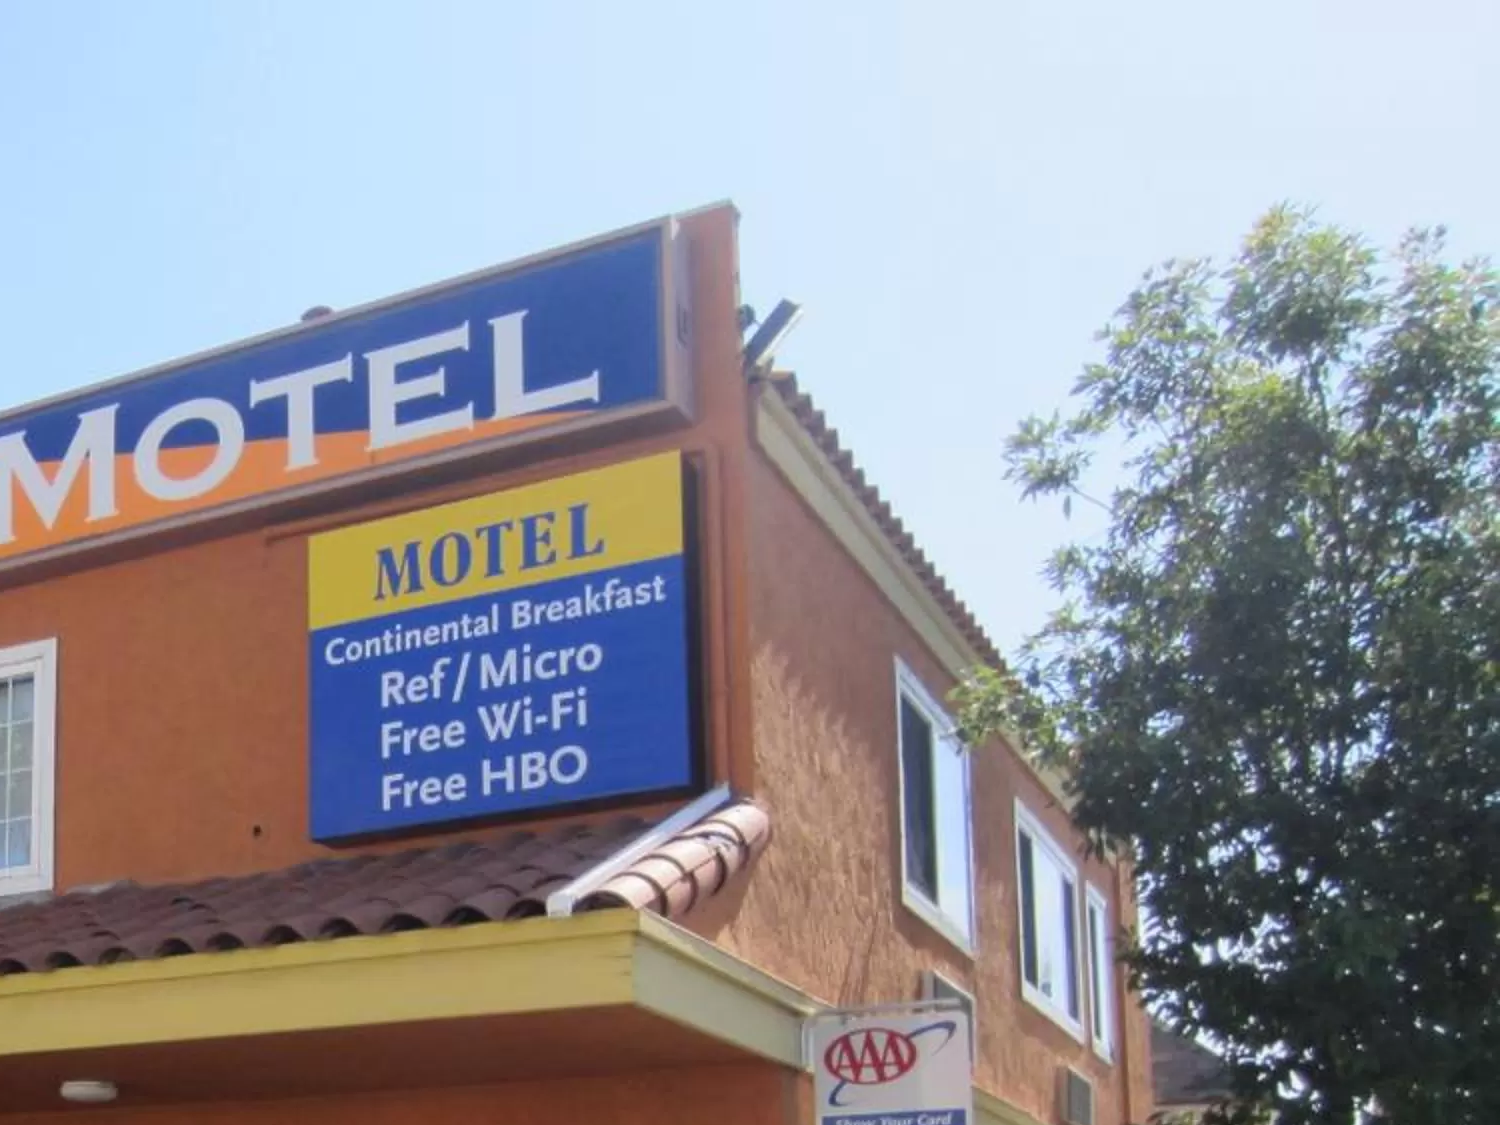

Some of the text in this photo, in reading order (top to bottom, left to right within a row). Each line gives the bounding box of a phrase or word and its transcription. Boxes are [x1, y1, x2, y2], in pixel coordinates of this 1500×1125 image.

[374, 503, 605, 601] MOTEL
[325, 575, 666, 665] Continental Breakfast
[381, 687, 587, 759] Free Wi-Fi
[382, 745, 588, 811] Free HBO
[831, 1028, 912, 1083] AAA
